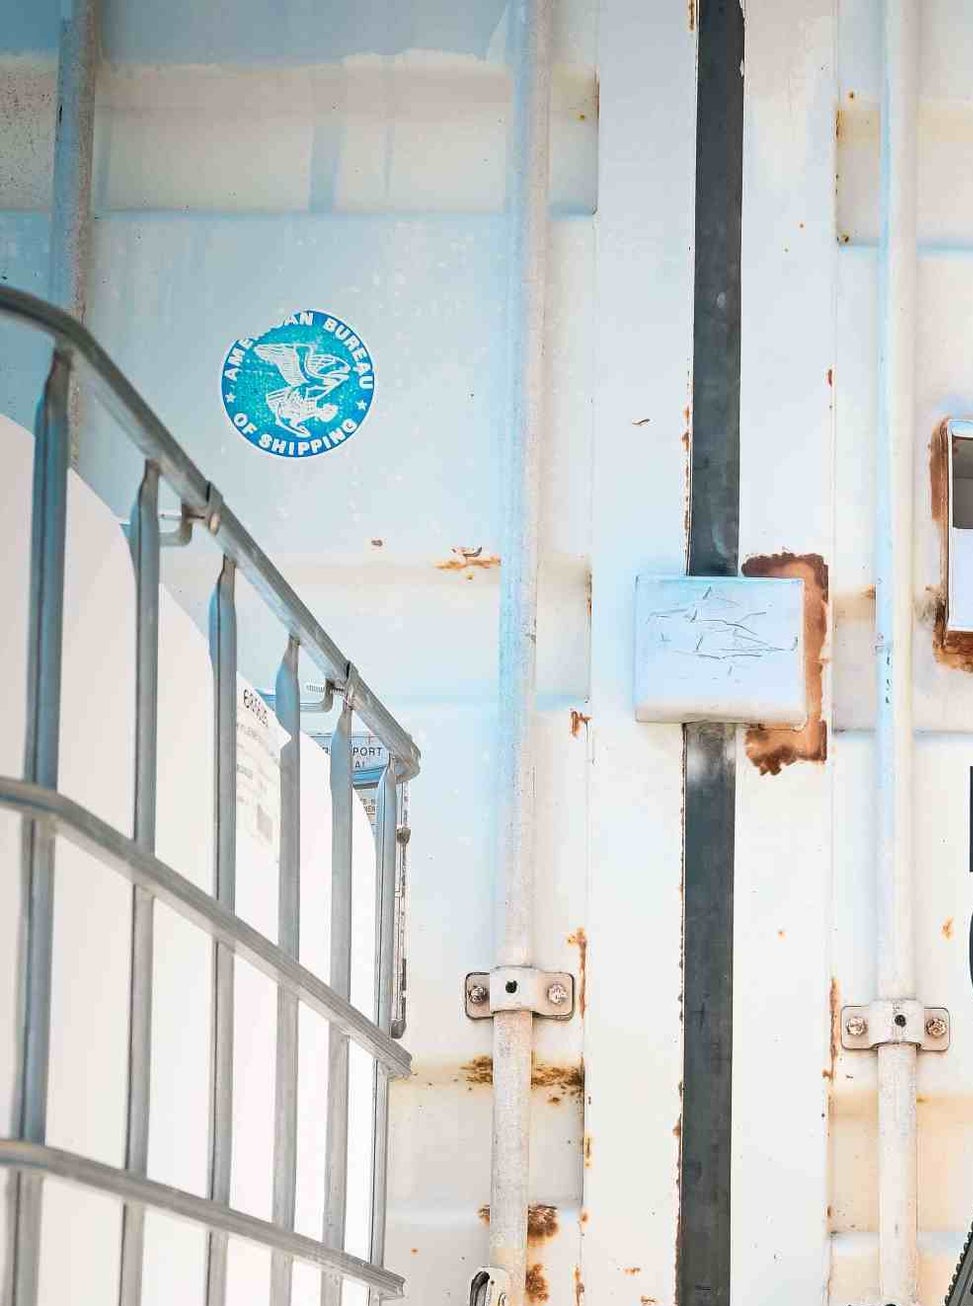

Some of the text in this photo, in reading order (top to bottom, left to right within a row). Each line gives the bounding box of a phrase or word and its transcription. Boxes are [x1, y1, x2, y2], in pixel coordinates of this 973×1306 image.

[224, 312, 375, 390] AMEAN BUREAU
[233, 412, 358, 456] OF SHIPPING
